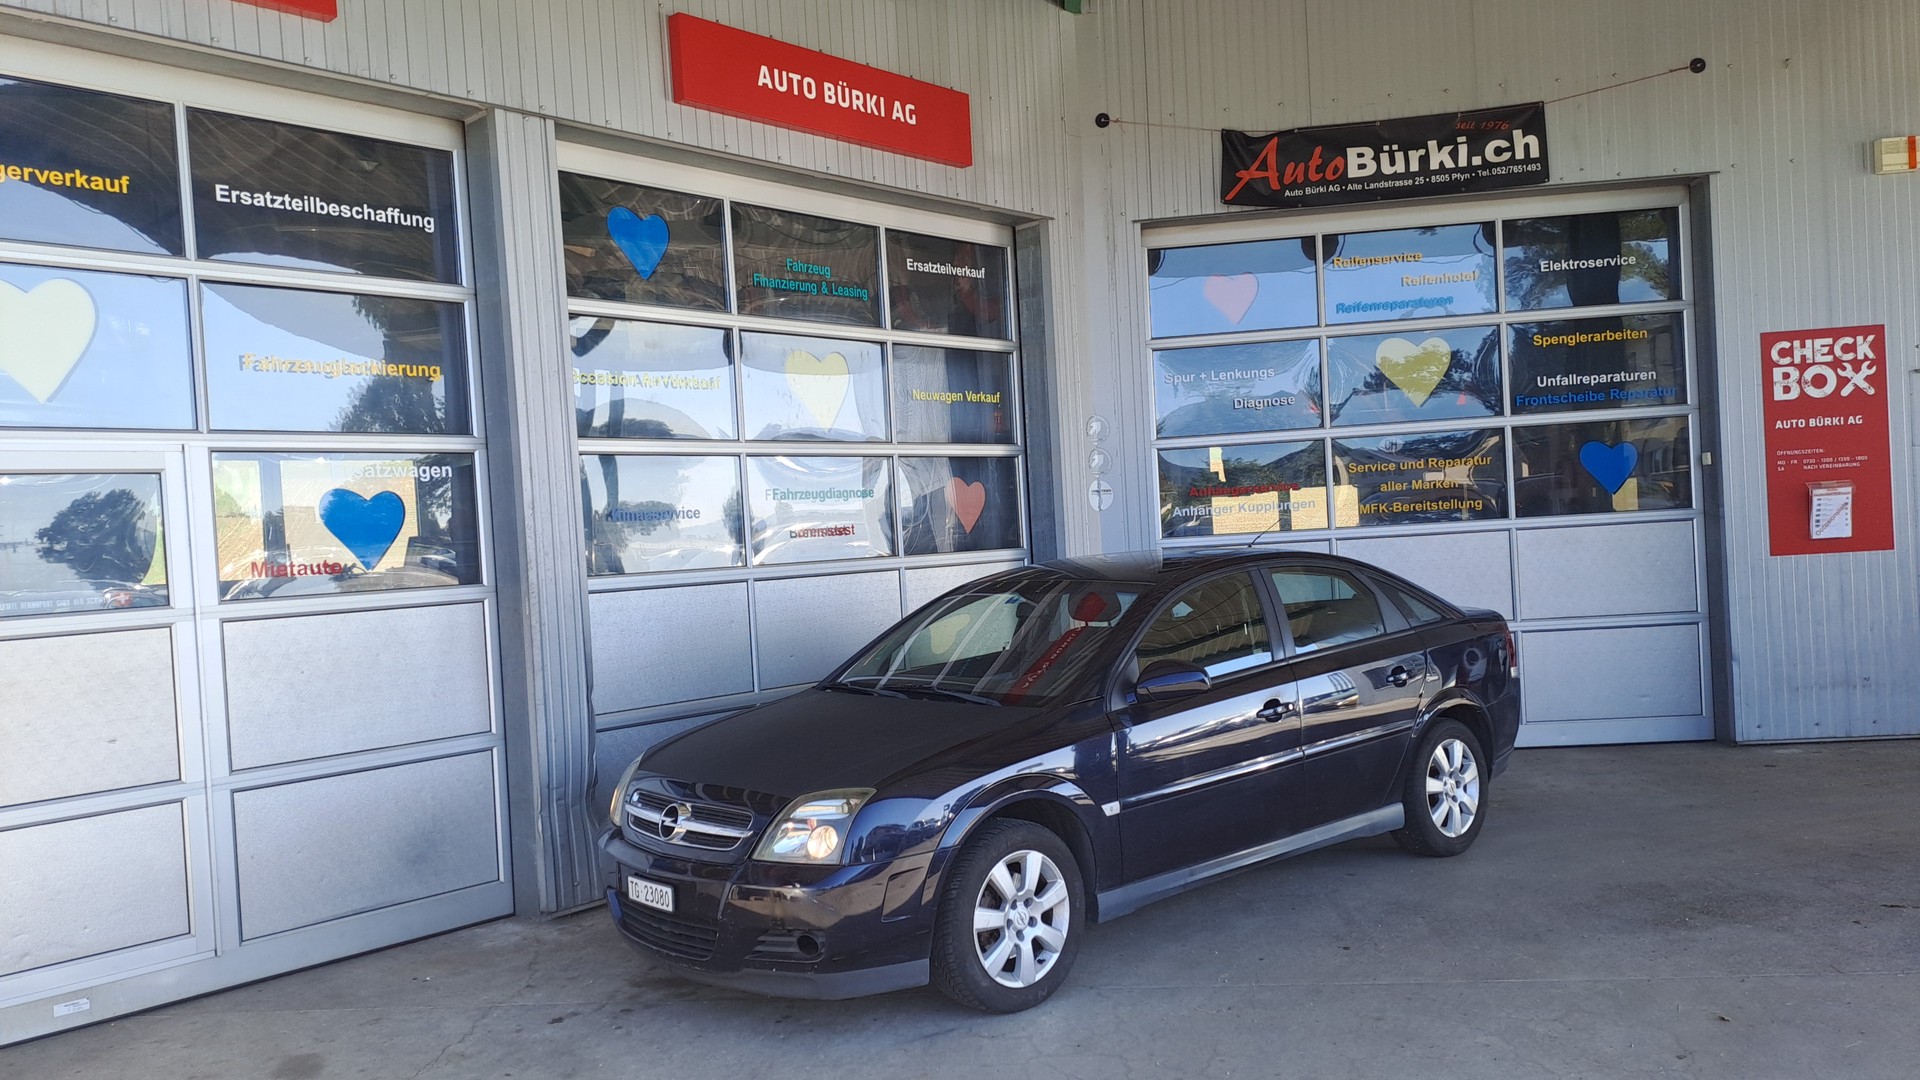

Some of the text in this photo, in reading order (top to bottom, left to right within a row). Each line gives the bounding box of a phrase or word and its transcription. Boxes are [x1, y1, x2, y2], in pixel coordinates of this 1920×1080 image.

[757, 64, 917, 126] AUTO BÜRKI AG
[1455, 119, 1509, 131] seit 1976
[1284, 189, 1304, 198] Auto
[1305, 186, 1327, 195] Bürki
[1328, 184, 1341, 192] AG
[1347, 183, 1363, 191] Alte
[1364, 179, 1413, 190] Landstrasse
[1414, 176, 1425, 185] 25
[1431, 174, 1450, 183] 8505
[1451, 173, 1470, 182] Pfyn
[215, 184, 435, 233] Ersatzteilbeschaffung
[786, 257, 831, 279] Fahrzeug
[906, 258, 986, 279] Ersatzteilverkauf
[1333, 251, 1423, 269] Reifenservice
[1540, 254, 1637, 272] Elektroservice
[753, 273, 869, 301] Finanzierung & Leasing
[1401, 271, 1477, 287] Reifenhotel
[1336, 296, 1453, 314] Reifenreparaturen
[1533, 329, 1648, 348] Spenglerarbeiten
[1771, 335, 1876, 365] CHECK
[240, 352, 442, 382] Fahrzeuglackierung
[1164, 368, 1275, 385] Spur + Lenkungs
[1537, 370, 1657, 387] Unfallreparaturen
[912, 389, 1000, 404] Neuwagen Verkauf
[1233, 396, 1296, 410] Diagnose
[1515, 386, 1677, 406] Frontscheibe Reparatur
[1775, 415, 1863, 429] AUTO BÜRKI AG
[1348, 456, 1493, 473] Service und Reparatur
[1189, 482, 1301, 497] Anhängerservice
[1380, 479, 1459, 492] aller Marken
[771, 487, 874, 503] Fahrzeugdiagnose
[1172, 499, 1316, 518] Anhänger Kupplungen
[1360, 499, 1483, 515] MFK-Bereitstellung
[250, 559, 343, 577] Mietauto
